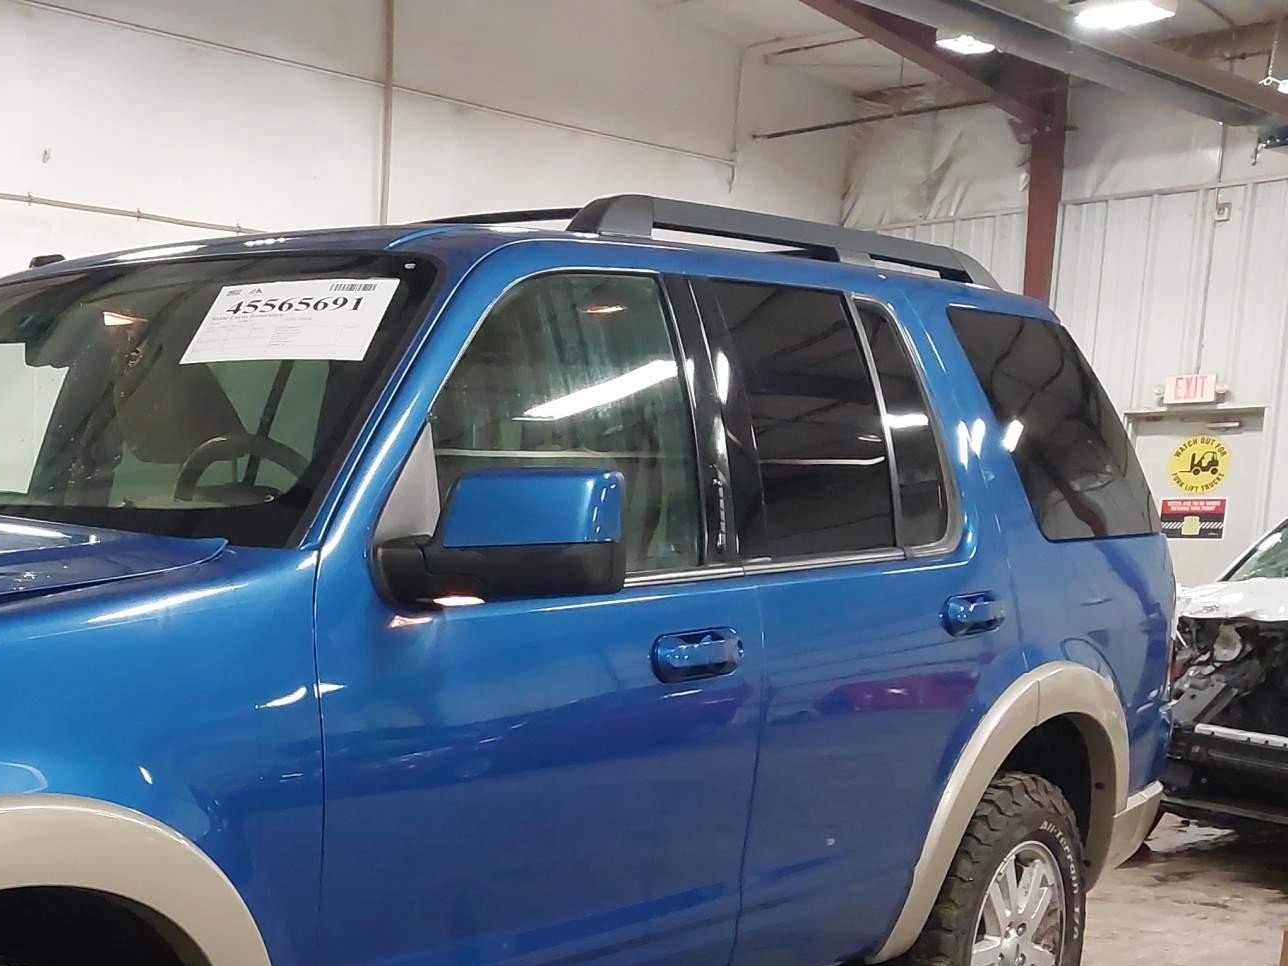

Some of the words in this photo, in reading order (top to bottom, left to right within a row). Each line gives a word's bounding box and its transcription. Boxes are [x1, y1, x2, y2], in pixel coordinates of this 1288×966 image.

[224, 296, 364, 315] 45565691
[1173, 375, 1208, 400] EXIT
[1173, 438, 1198, 458] WATCH
[1200, 437, 1216, 446] OUT
[1214, 442, 1228, 457] FOR
[1184, 483, 1199, 493] LIFT
